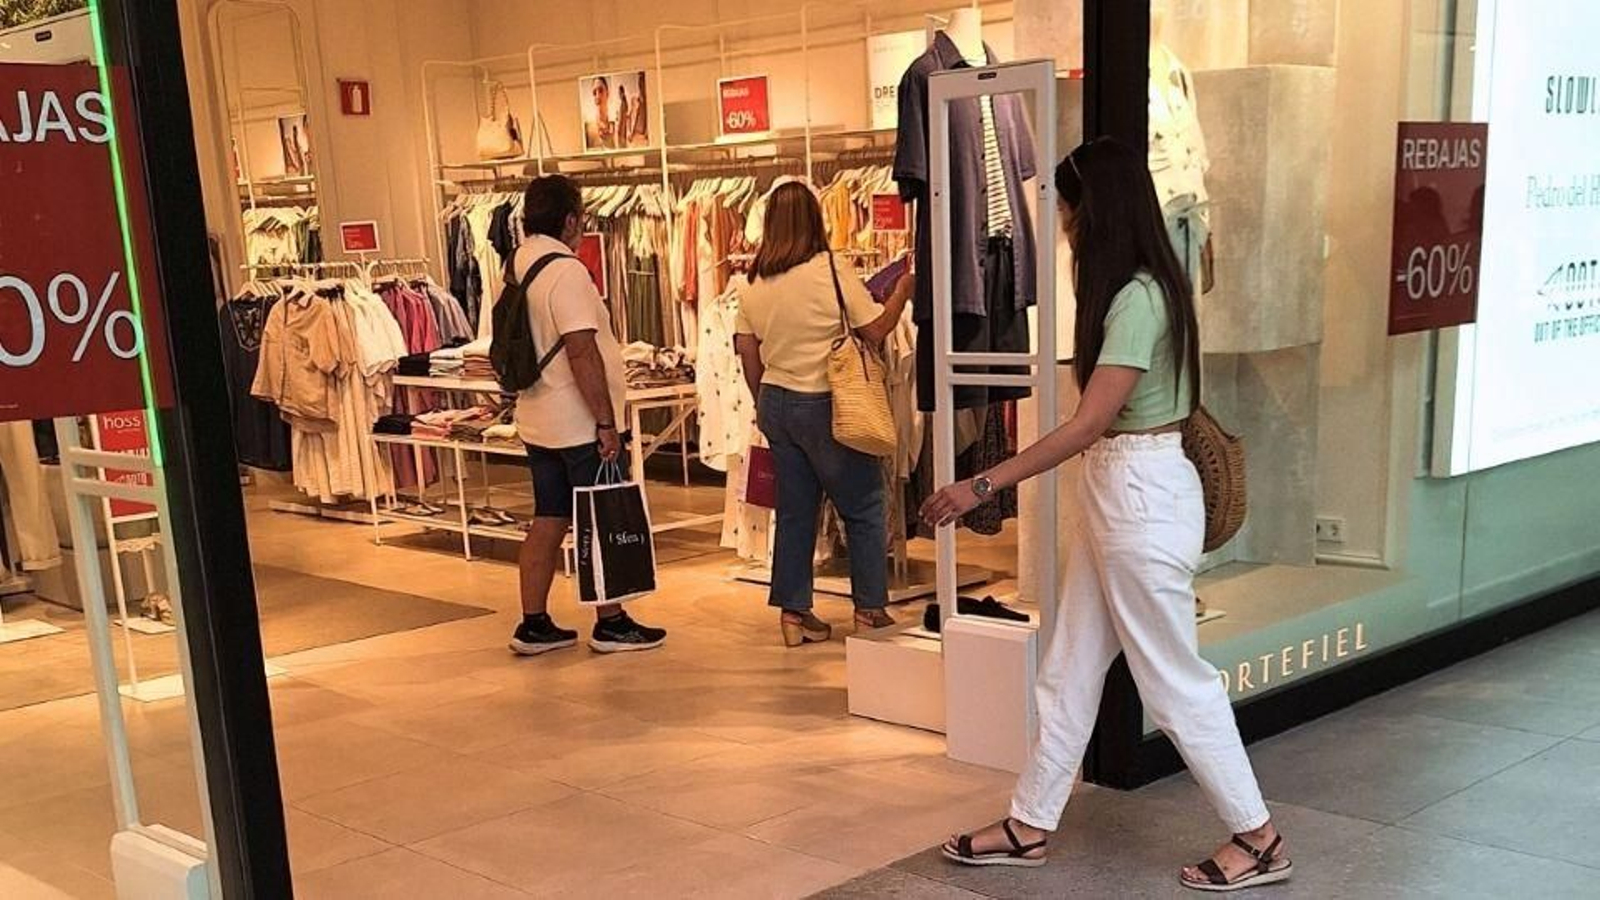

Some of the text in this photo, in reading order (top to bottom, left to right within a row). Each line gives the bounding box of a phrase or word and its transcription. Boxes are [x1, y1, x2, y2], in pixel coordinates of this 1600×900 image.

[1401, 138, 1482, 170] REBAJAS
[1396, 242, 1473, 300] -60%
[102, 415, 141, 430] hoss
